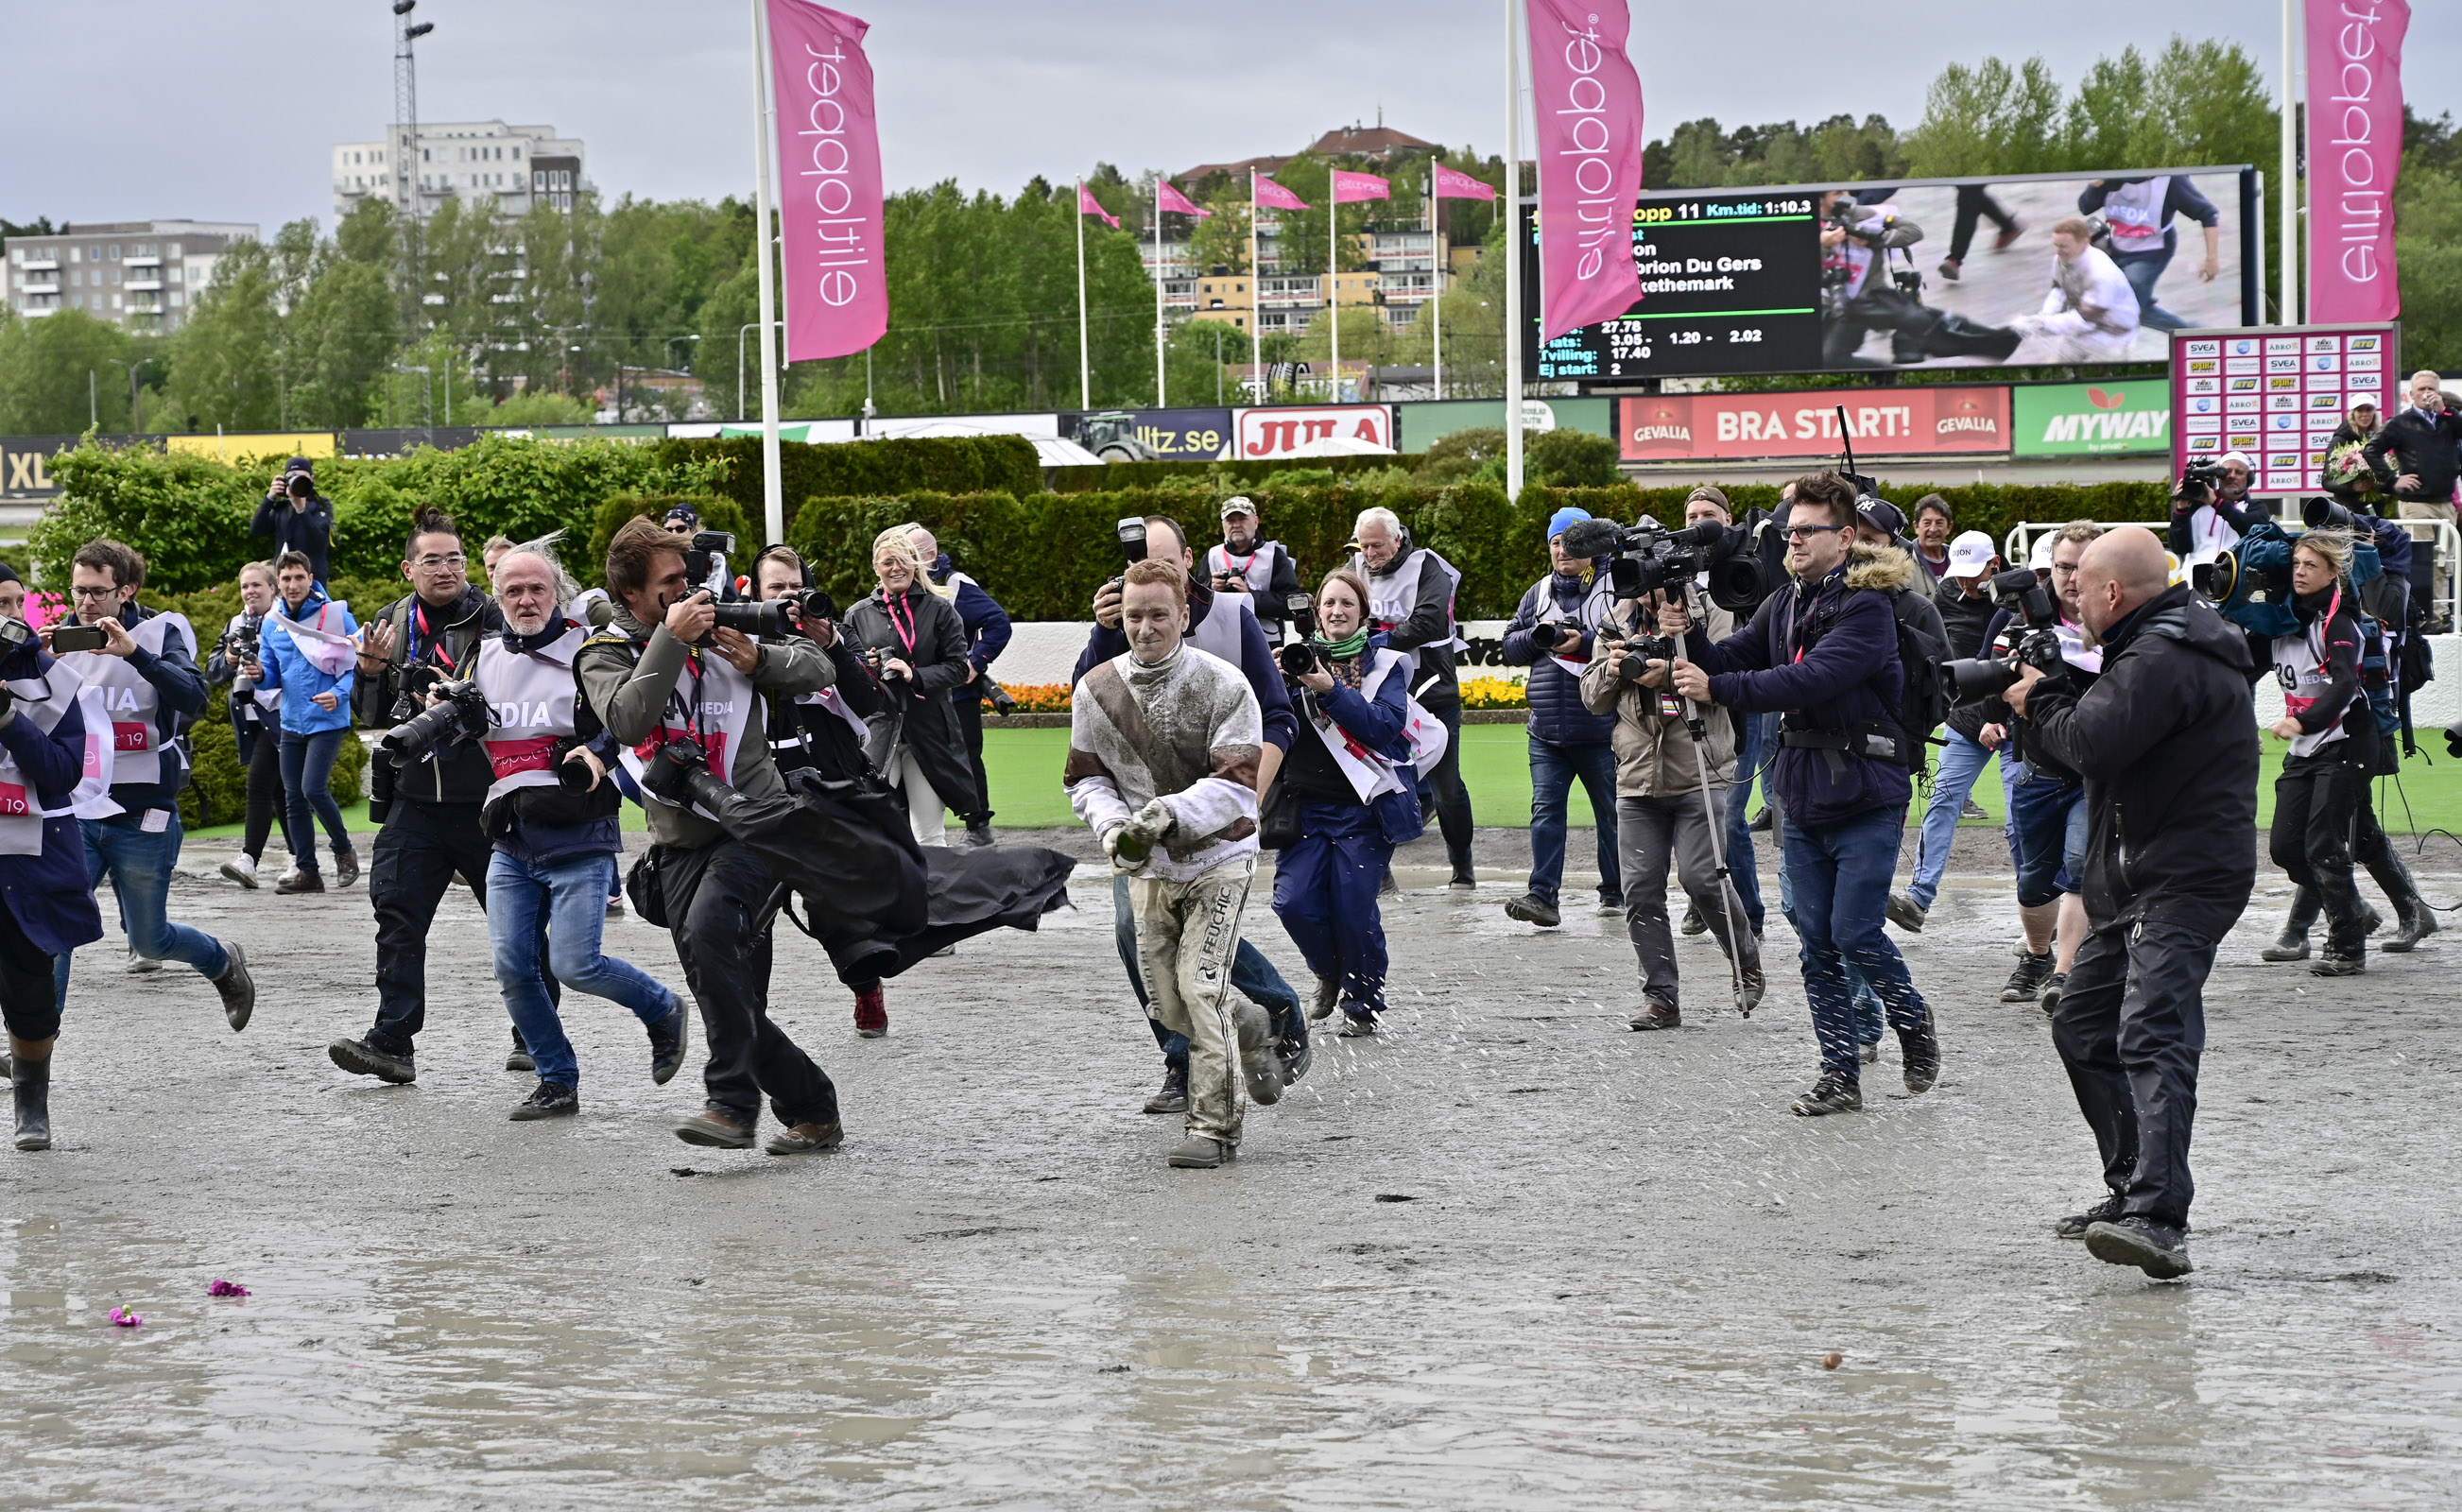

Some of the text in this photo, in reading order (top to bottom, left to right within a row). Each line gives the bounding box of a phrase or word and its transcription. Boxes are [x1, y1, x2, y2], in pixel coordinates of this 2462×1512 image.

[1632, 200, 1812, 223] opp 11 Km.tid: 1:10.3
[1636, 256, 1763, 276] brion Du Gers
[1639, 275, 1734, 294] kethemark
[1601, 320, 1642, 335] 27.78
[1539, 335, 1582, 349] lats:
[1610, 334, 1643, 347] 3.05
[1669, 332, 1701, 345] 1.20
[1730, 329, 1763, 343] 2.02
[2352, 339, 2374, 349] ATG
[1539, 346, 1652, 364] Tvilling: 17.40
[2191, 343, 2216, 352] SVEA
[1539, 363, 1622, 379] Ej start: 2
[2233, 380, 2255, 389] ATG
[2351, 376, 2377, 385] SVEA
[2314, 397, 2335, 406] ATG
[1716, 406, 1910, 442] BRA START!
[1937, 417, 1997, 435] GEVALIA
[2042, 410, 2170, 442] MYWAY
[1137, 425, 1220, 453] lltz.se
[1634, 425, 1692, 442] GEVALIA
[2312, 436, 2331, 444] SVE
[2194, 438, 2214, 447] ATG
[2274, 457, 2295, 466] ATG
[2312, 454, 2326, 464] SPO
[1370, 598, 1405, 617] DIA
[2297, 674, 2326, 685] MED
[488, 701, 553, 729] EDIA
[127, 731, 144, 747] 19
[6, 798, 26, 814] 19
